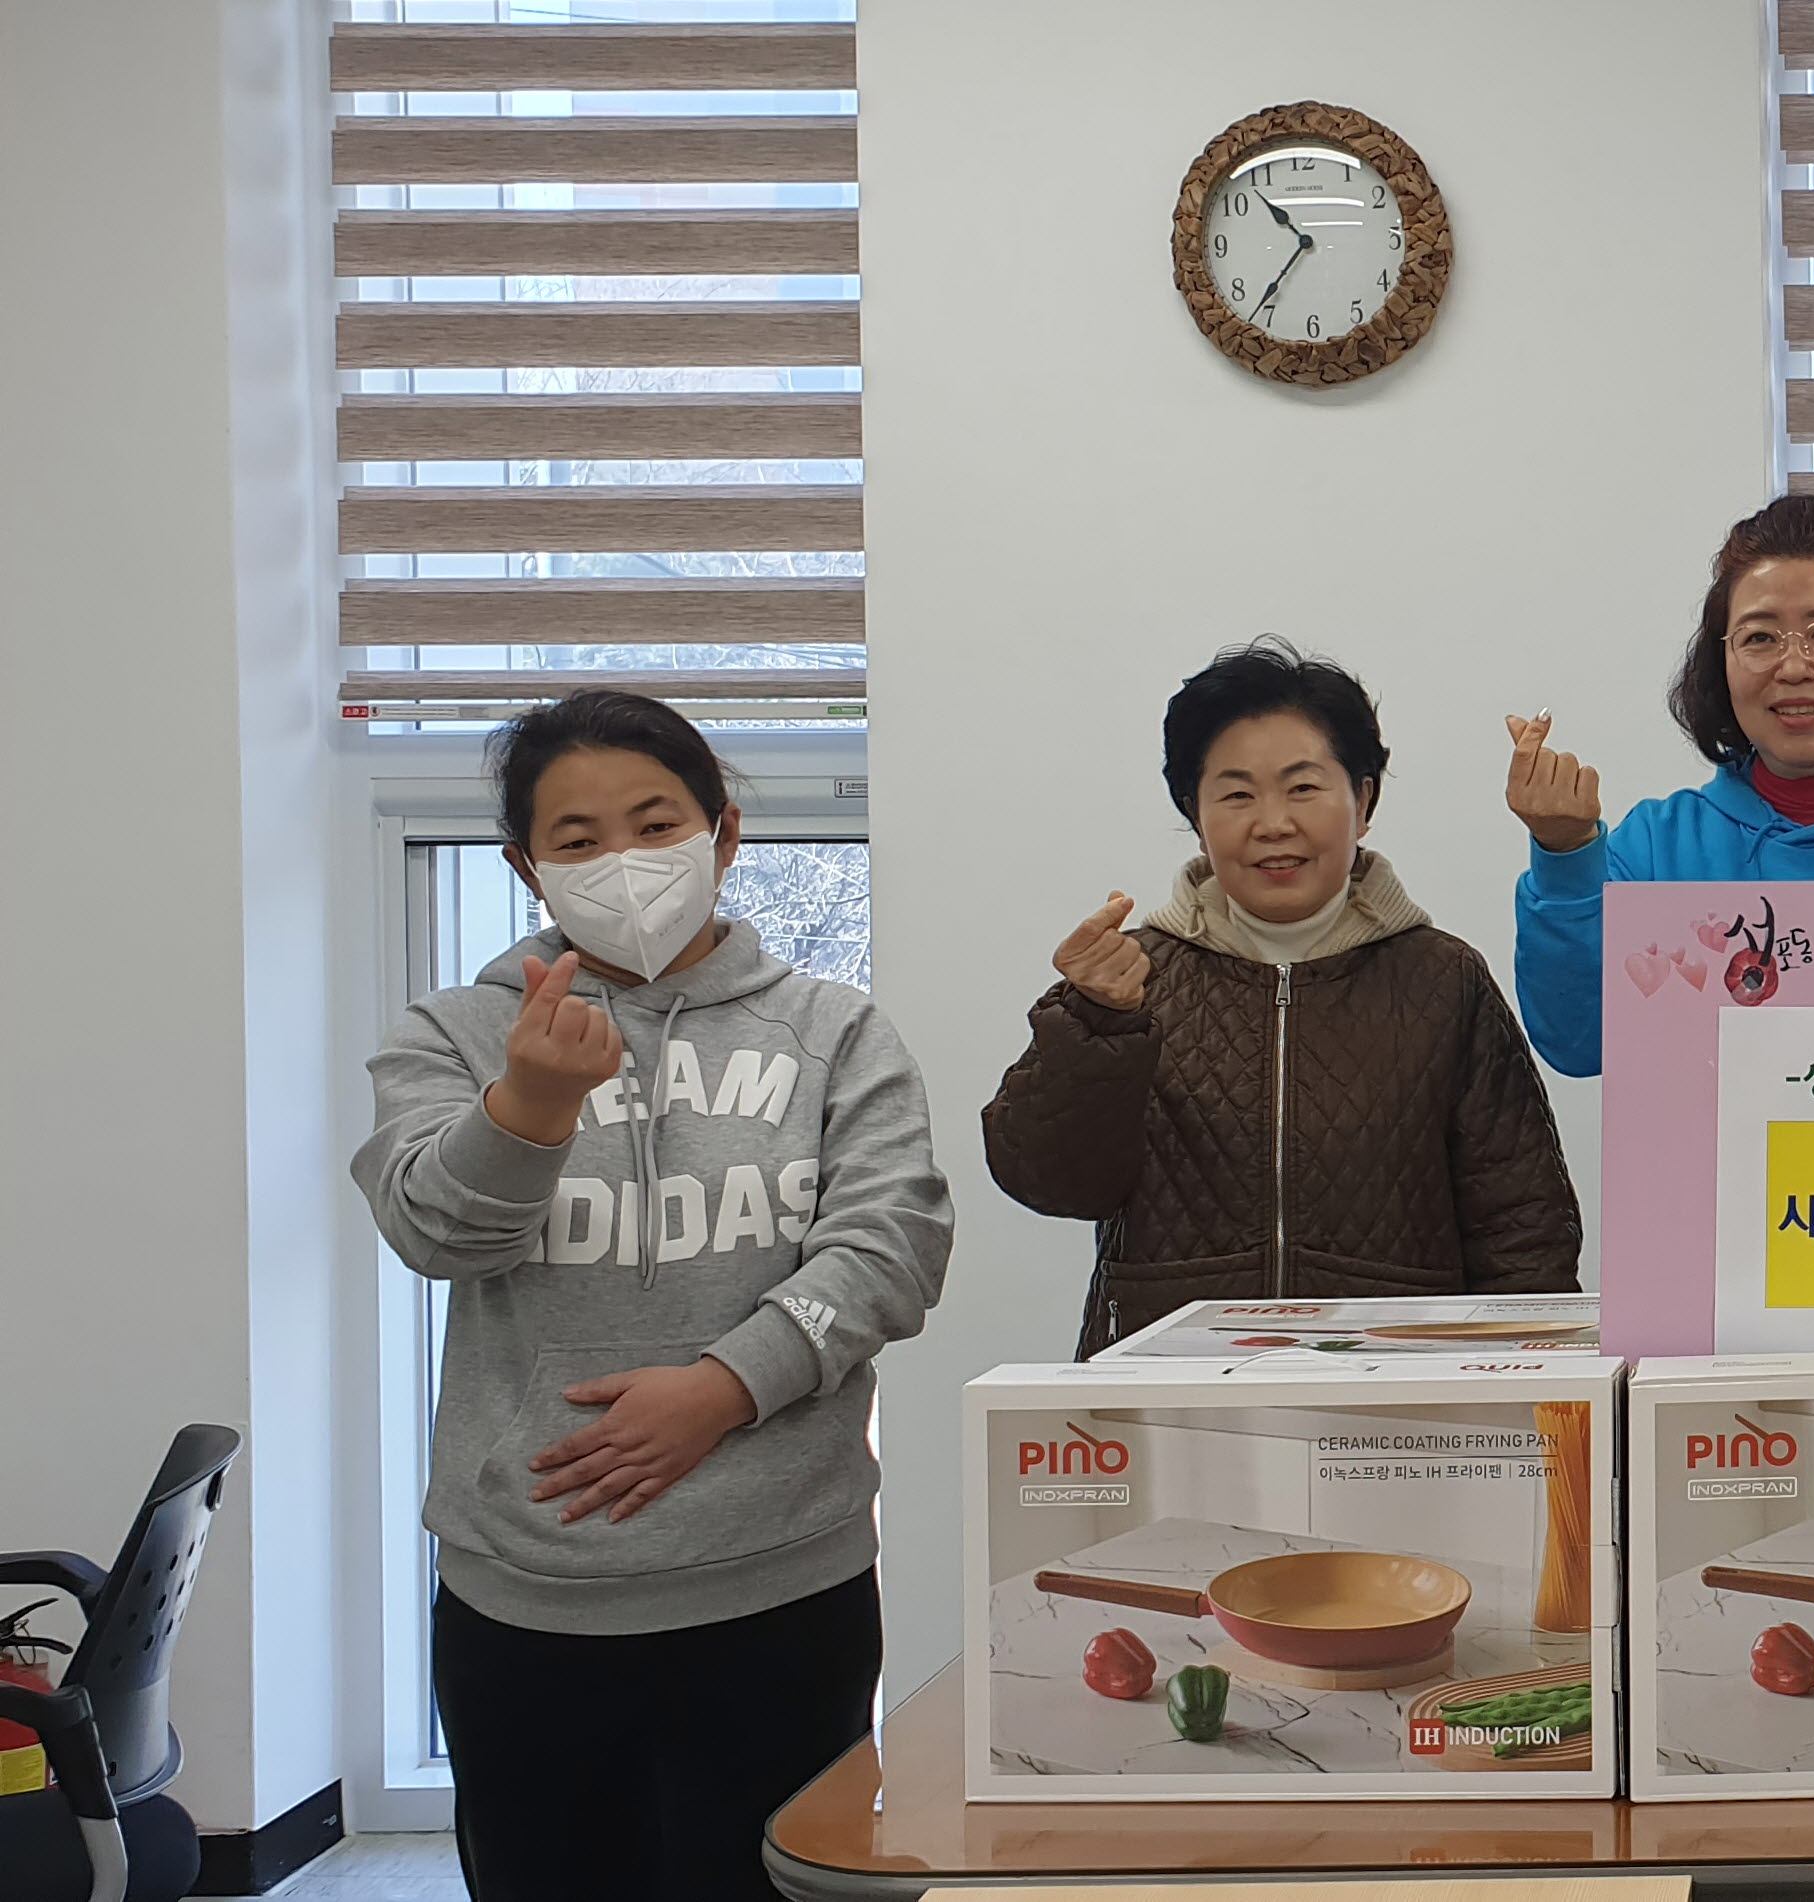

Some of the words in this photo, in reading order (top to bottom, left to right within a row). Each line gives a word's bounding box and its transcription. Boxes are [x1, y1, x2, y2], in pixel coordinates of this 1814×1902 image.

[1250, 163, 1274, 186] 11
[1343, 164, 1352, 182] 1
[1223, 192, 1248, 217] 10
[1372, 185, 1386, 209] 2
[1214, 234, 1228, 258] 9
[1388, 226, 1401, 250] 3
[1232, 278, 1246, 301] 8
[1376, 269, 1391, 292] 4
[1263, 305, 1275, 328] 7
[1350, 299, 1363, 324] 5
[1307, 315, 1320, 338] 6
[577, 1040, 799, 1131] EAM
[524, 1159, 819, 1266] DIDAS
[783, 1297, 826, 1349] adidas
[1318, 1436, 1389, 1451] CERAMIC
[1393, 1435, 1461, 1449] COATING
[1465, 1434, 1523, 1448] FRYING
[1526, 1434, 1558, 1447] PAN
[1319, 1465, 1389, 1481] 이녹스프랑
[1394, 1465, 1421, 1480] 피노
[1426, 1466, 1441, 1479] IH
[1446, 1464, 1502, 1480] 프라이팬
[1518, 1464, 1558, 1478] 28cm
[1024, 1489, 1125, 1501] INOXPRAN
[1692, 1481, 1793, 1496] INOXPRAN
[1413, 1728, 1441, 1746] IH
[1449, 1726, 1560, 1746] INDUCTION
